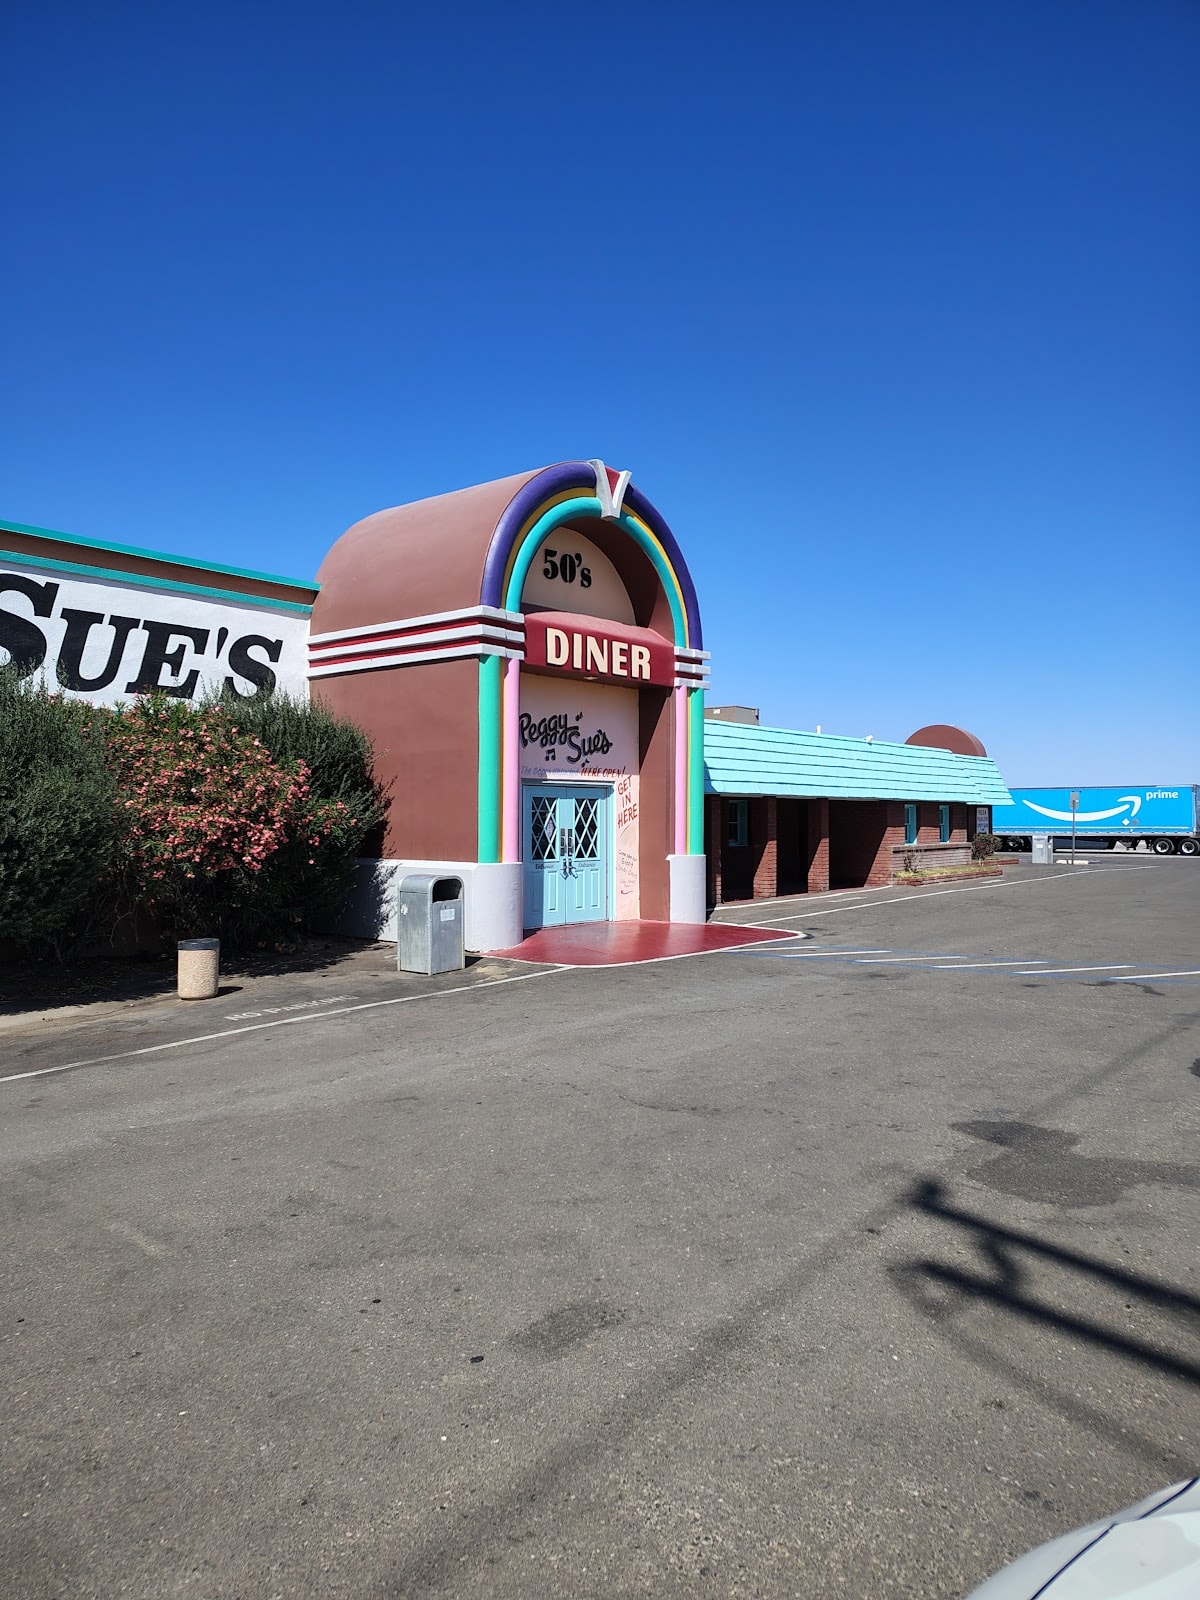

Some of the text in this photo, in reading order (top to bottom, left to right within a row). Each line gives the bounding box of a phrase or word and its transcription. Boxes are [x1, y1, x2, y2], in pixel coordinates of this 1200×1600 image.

[543, 549, 592, 588] 50's
[0, 573, 283, 700] SUE'S
[546, 627, 651, 680] DINER
[519, 712, 579, 748] Peggy
[566, 729, 613, 763] Sue's
[617, 774, 633, 795] GET
[1145, 789, 1179, 801] prime
[617, 803, 638, 829] HERE
[621, 793, 632, 809] IN
[223, 1010, 262, 1021] NO
